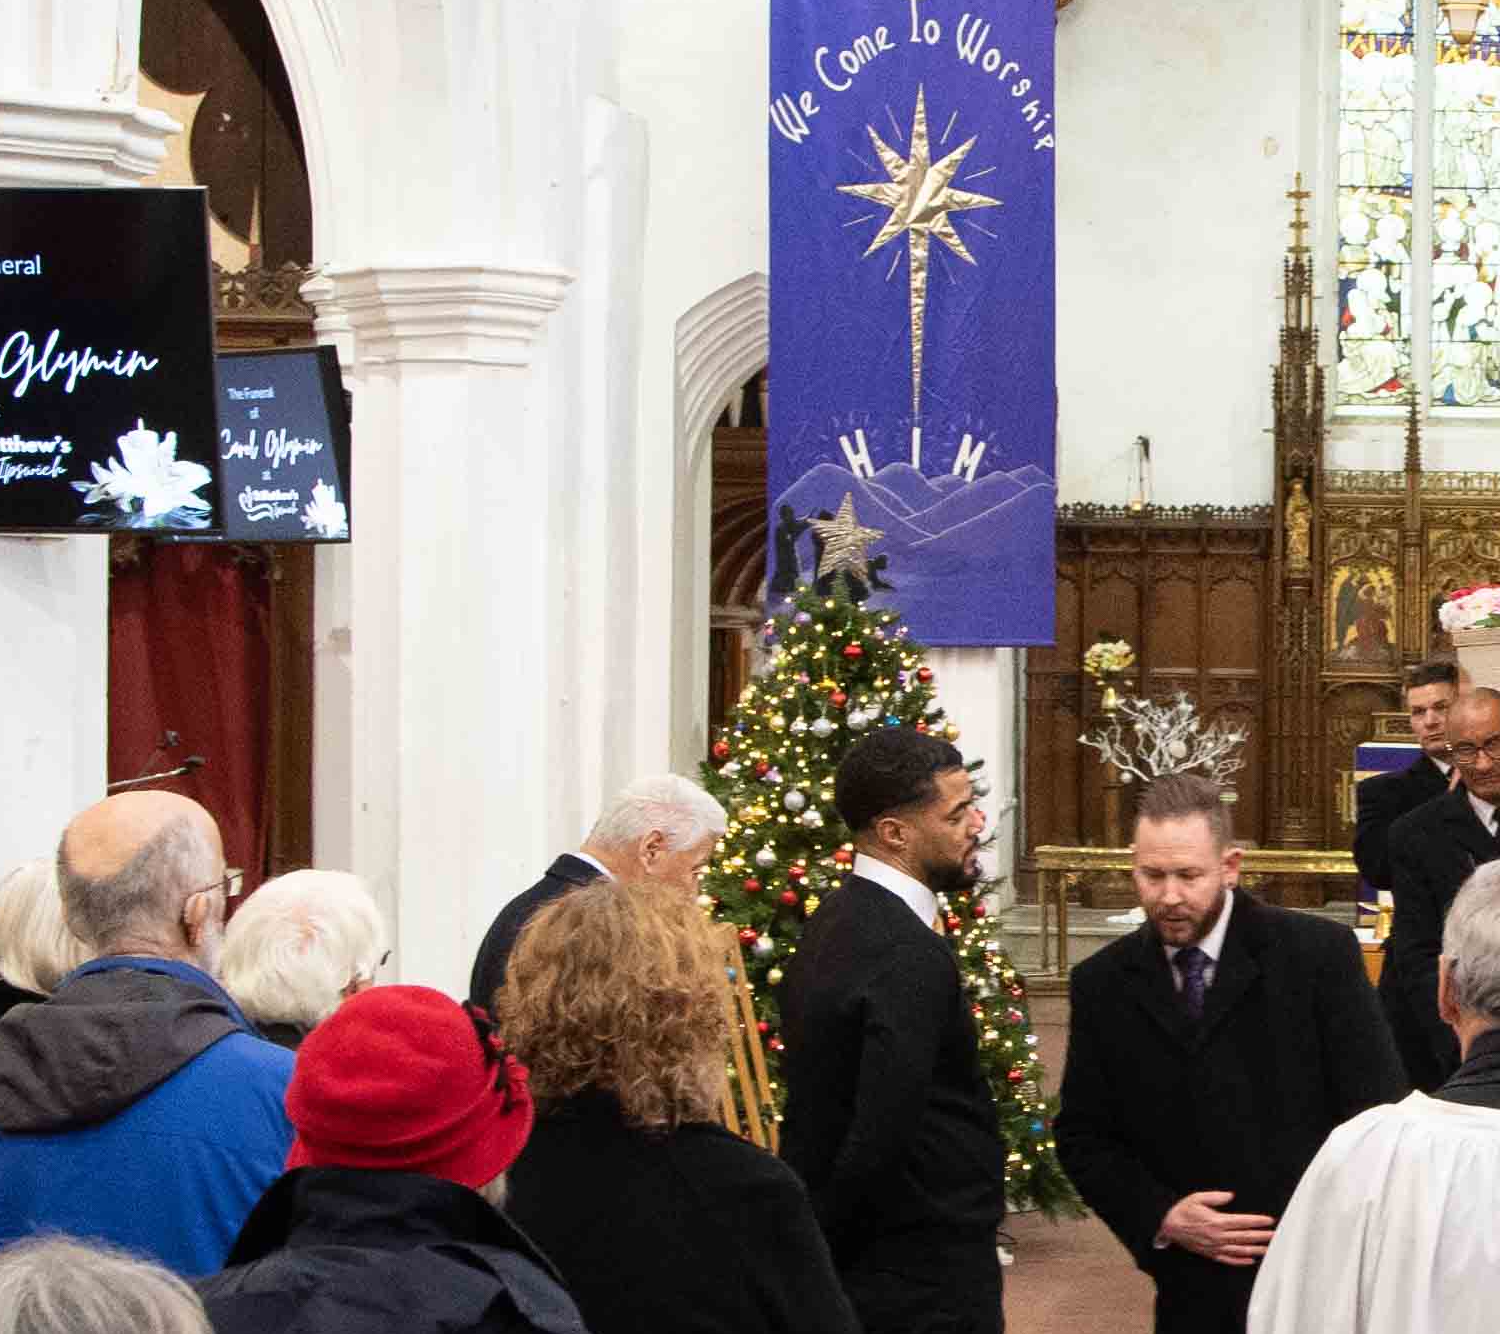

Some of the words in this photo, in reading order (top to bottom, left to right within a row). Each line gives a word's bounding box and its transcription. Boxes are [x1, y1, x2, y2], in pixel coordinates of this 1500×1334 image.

[770, 91, 820, 144] We
[814, 26, 896, 92] Come
[956, 13, 1055, 151] Worship
